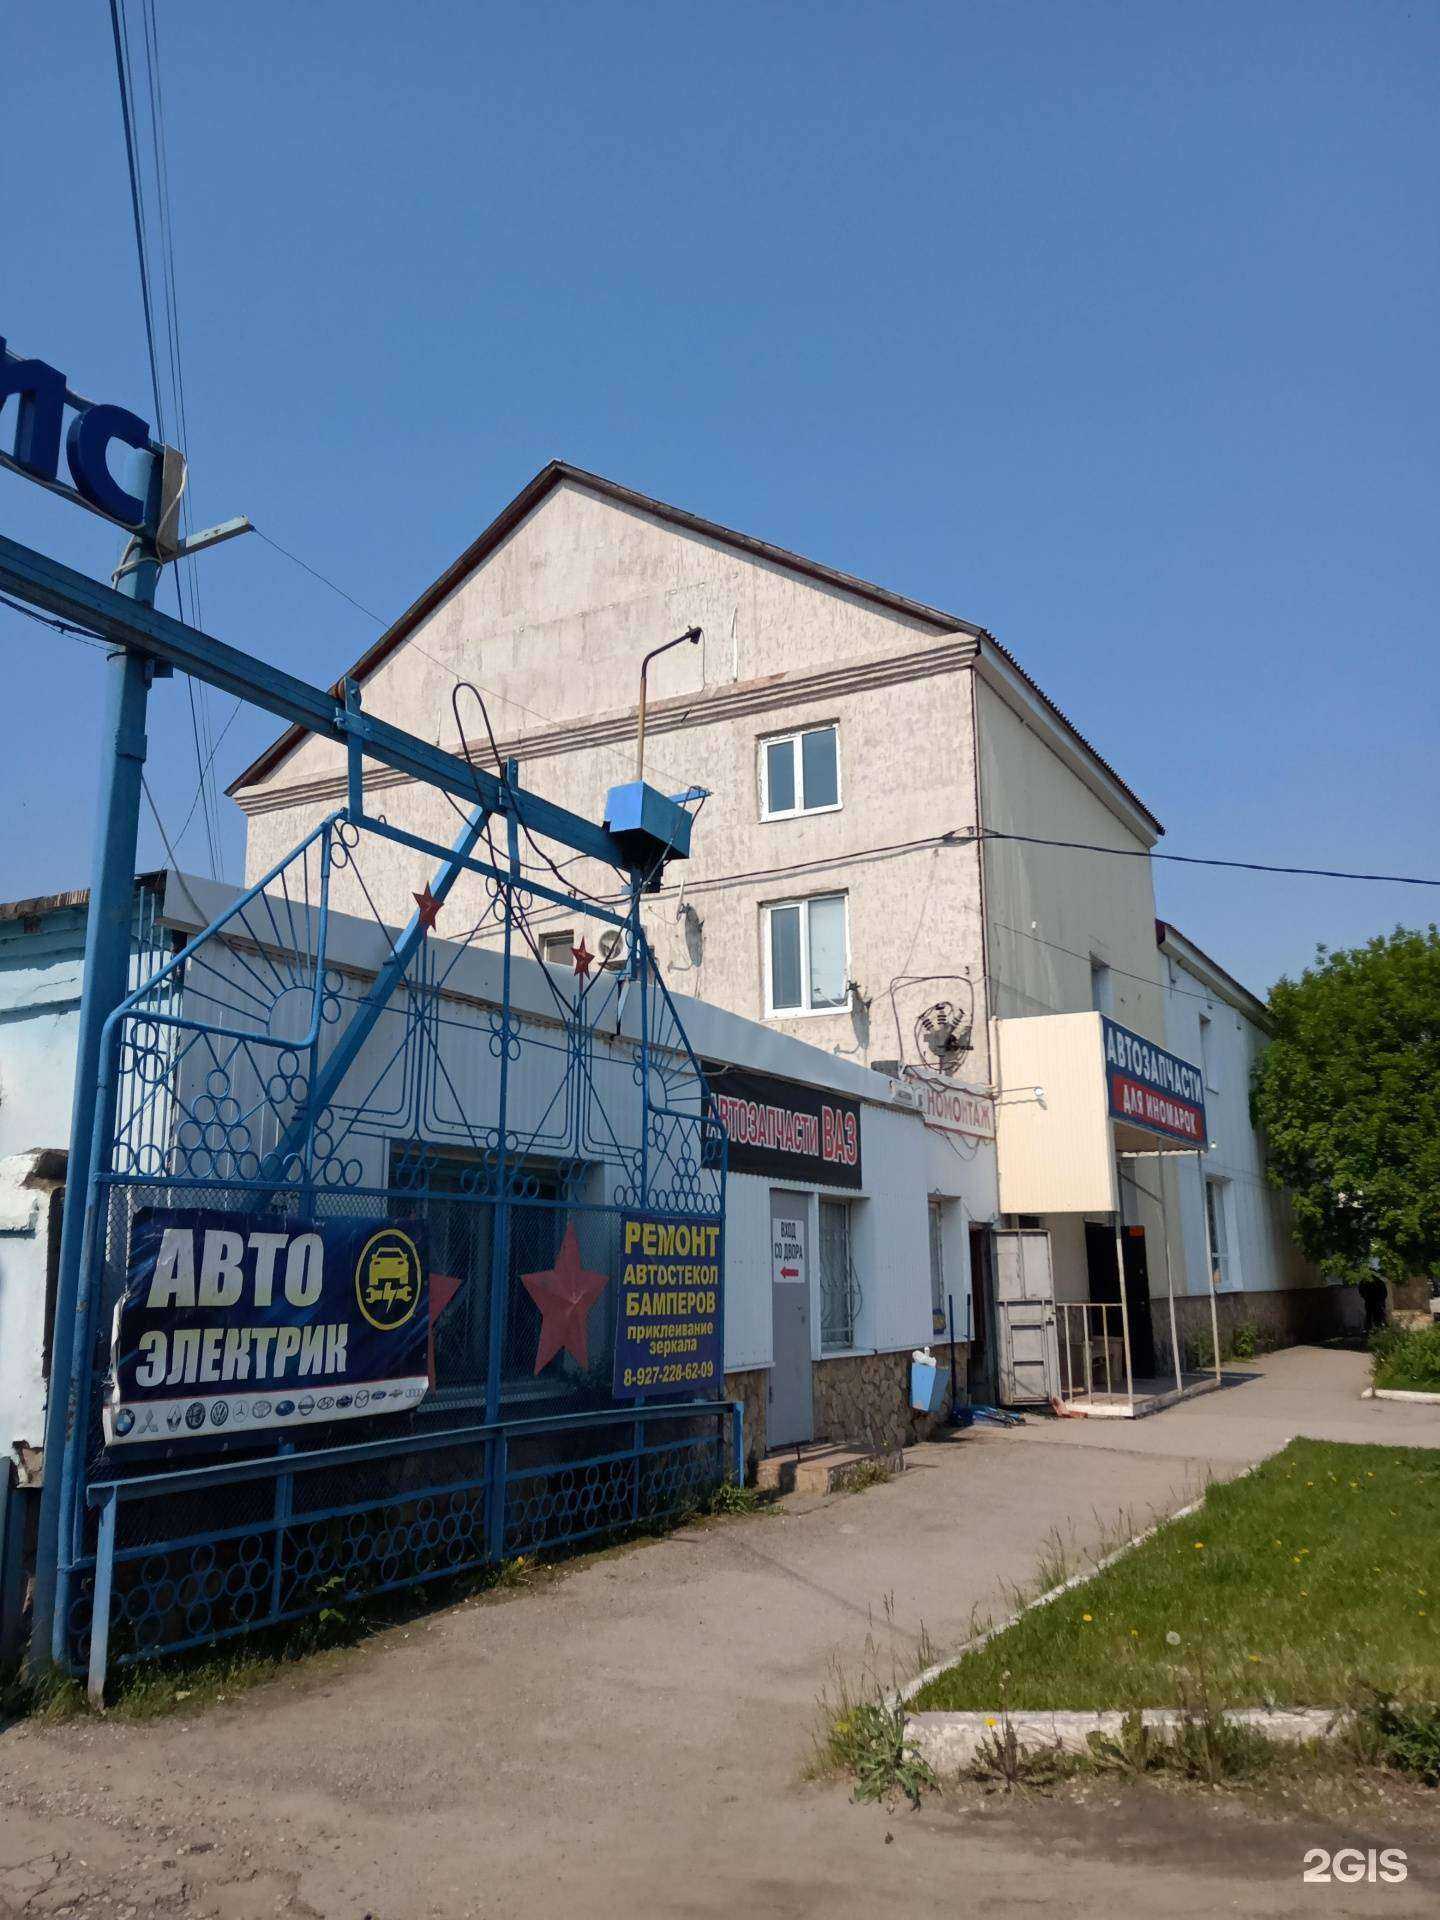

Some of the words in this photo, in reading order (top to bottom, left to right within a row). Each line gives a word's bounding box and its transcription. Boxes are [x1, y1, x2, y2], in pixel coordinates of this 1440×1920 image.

[1107, 1027, 1203, 1104] АВТОЗАПЧАСТИ
[926, 1087, 991, 1130] НОМОНТАЖ
[1122, 1084, 1144, 1115] ДЛЯ
[1146, 1093, 1197, 1134] ИНОМАРОК
[821, 1104, 858, 1166] ВАЗ
[624, 1221, 720, 1257] РЕМОНТ
[780, 1221, 797, 1240] ВХОД
[146, 1228, 325, 1309] АВТО
[774, 1242, 783, 1259] СО
[783, 1243, 803, 1261] ДВОРА
[623, 1263, 719, 1286] АВТОСТЕКОЛ
[626, 1291, 716, 1317] БАМПЕРОВ
[627, 1321, 714, 1343] приклеивание
[649, 1338, 698, 1358] зеркала
[135, 1323, 349, 1387] ЭЛЕКТРИК
